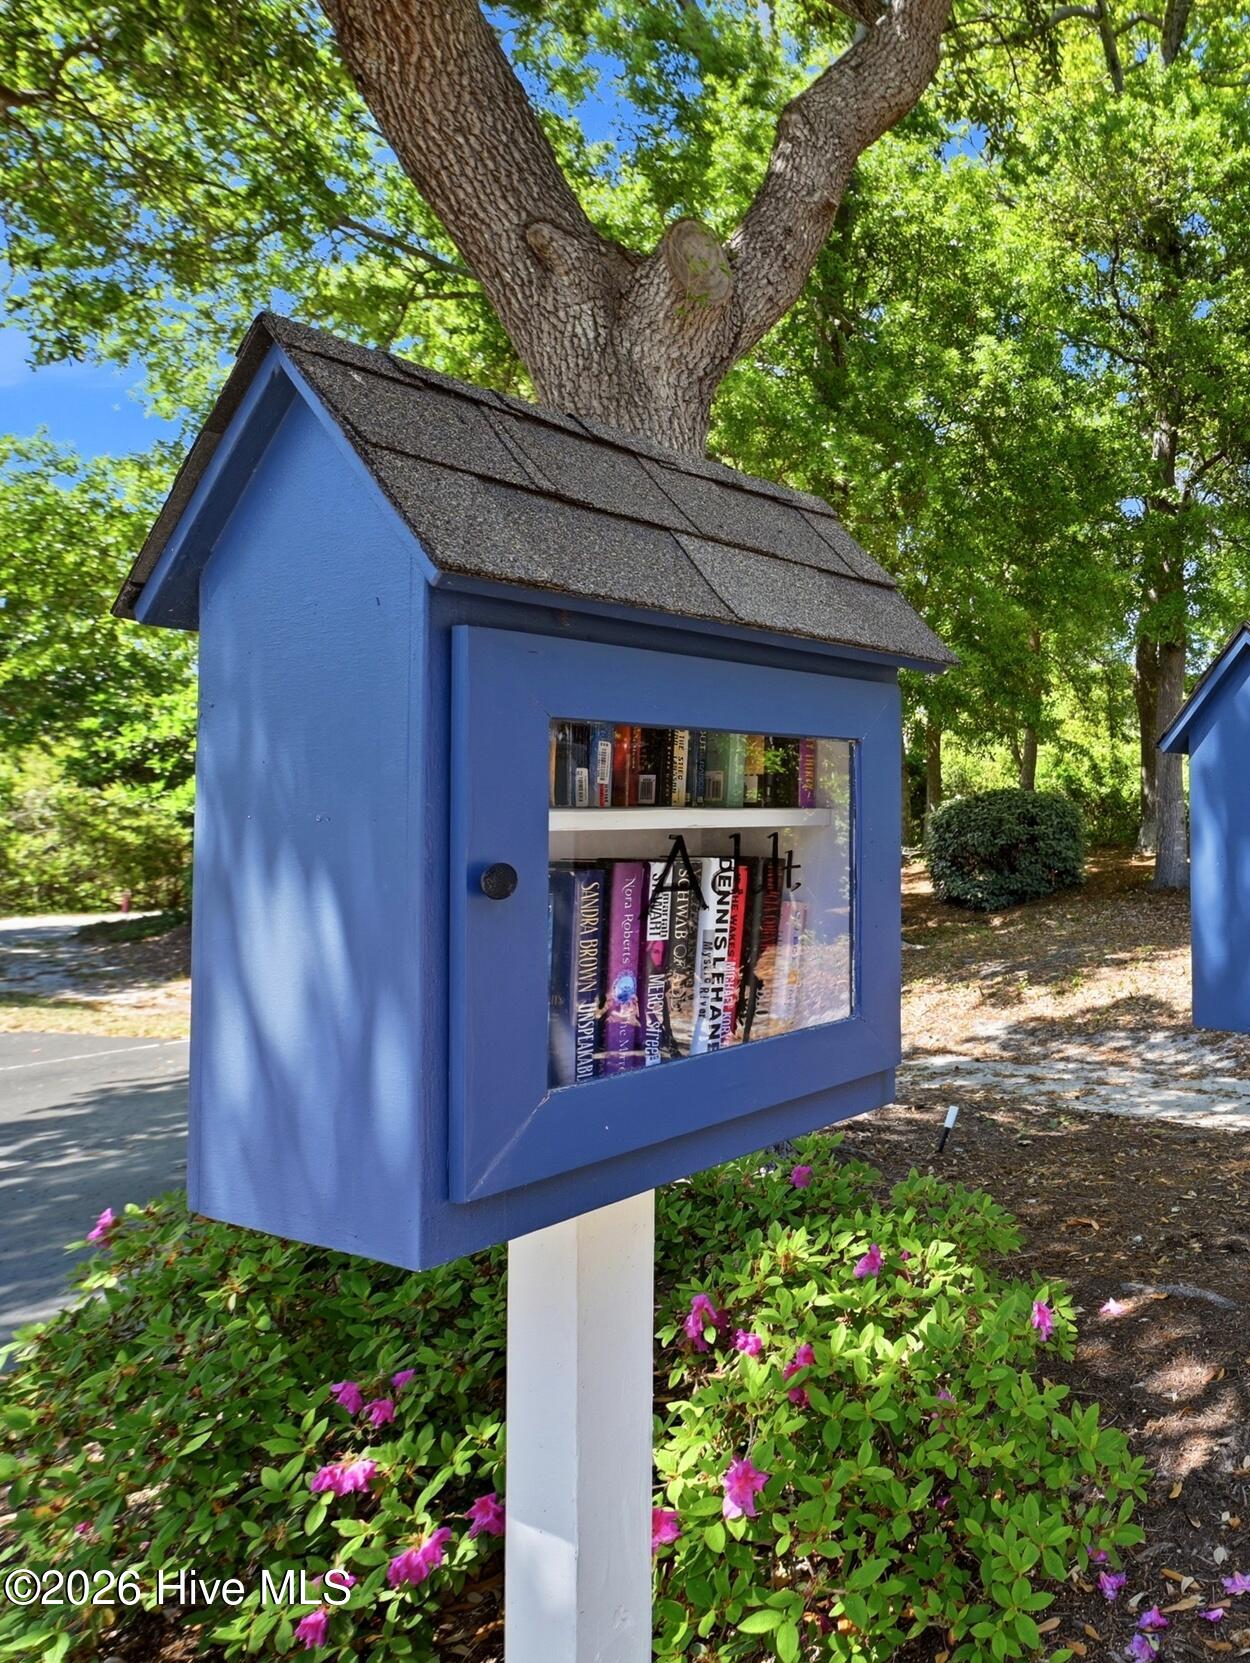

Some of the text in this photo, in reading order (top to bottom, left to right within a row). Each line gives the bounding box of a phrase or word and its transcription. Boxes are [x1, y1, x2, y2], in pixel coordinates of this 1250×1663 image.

[580, 881, 600, 936] SANDRA
[621, 876, 636, 909] Nora
[648, 872, 663, 936] SWART
[674, 868, 691, 939] SCHWAB
[714, 858, 735, 950] DENNIS
[621, 914, 634, 965] Roberts
[727, 914, 739, 958] WAKES
[578, 938, 599, 993] BROWN
[722, 961, 738, 1008] MICHAEL
[645, 973, 665, 1060] MERCY stree
[698, 986, 710, 1019] River
[707, 956, 724, 1051] LEHANE
